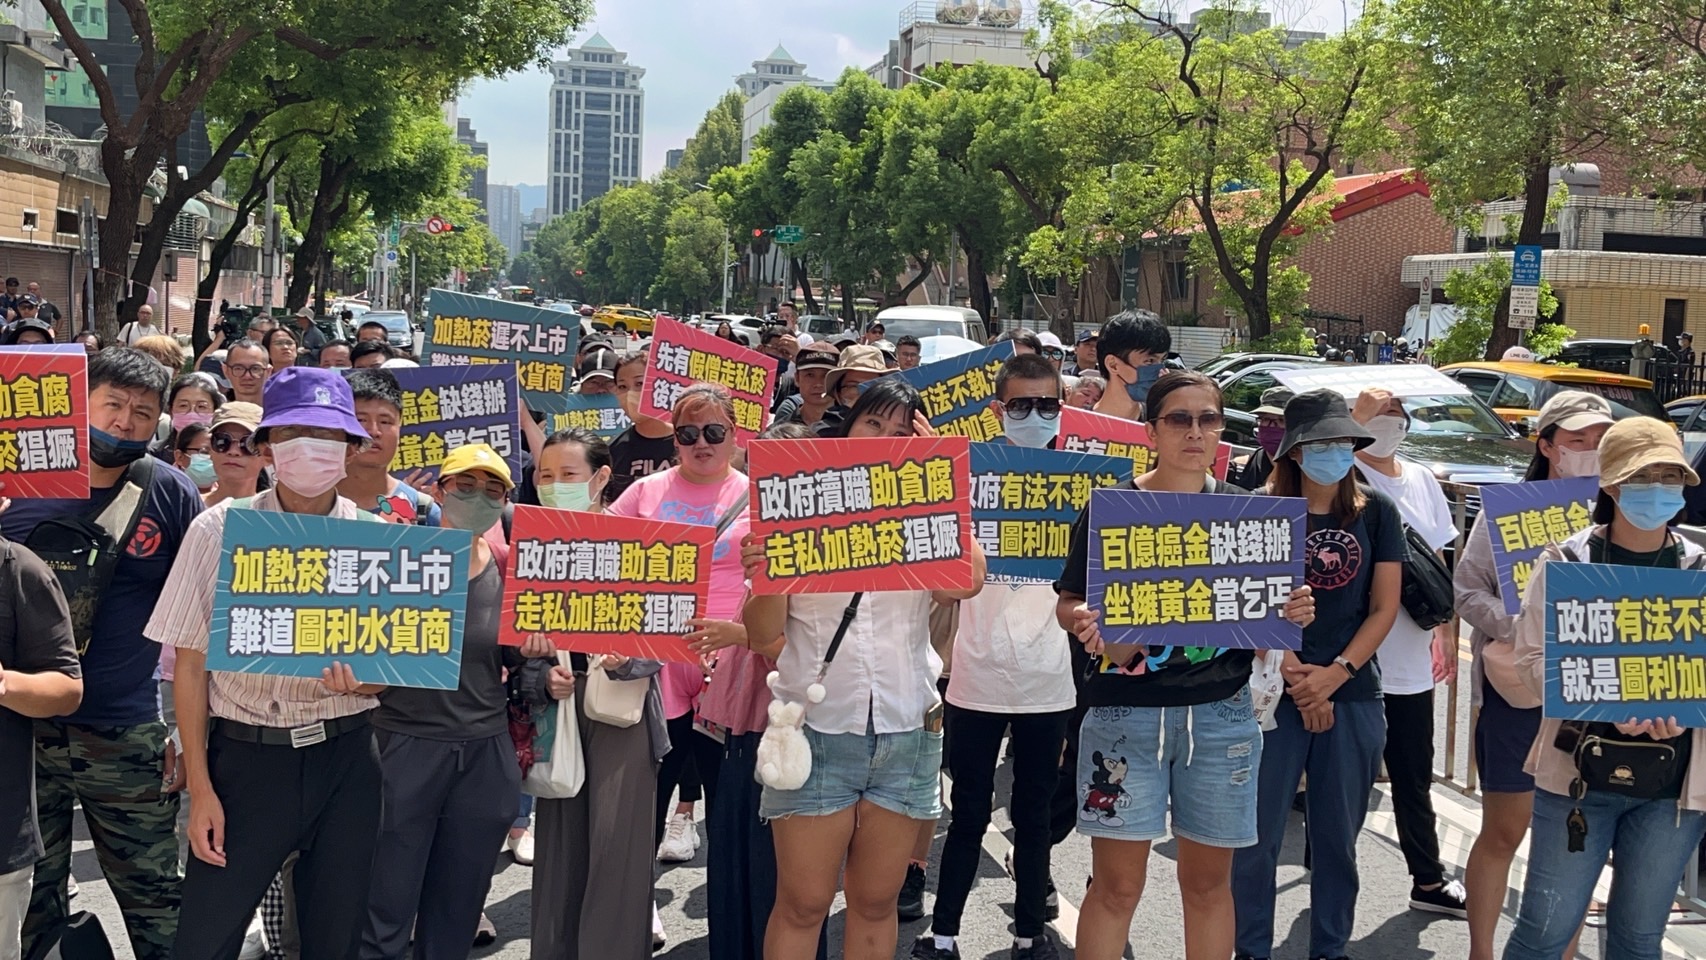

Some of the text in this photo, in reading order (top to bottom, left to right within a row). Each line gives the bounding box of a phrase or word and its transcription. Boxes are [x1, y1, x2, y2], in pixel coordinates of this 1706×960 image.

[432, 315, 567, 356] 加熱菸遲不上市
[656, 341, 767, 396] 先有假僧走私菸
[630, 459, 673, 476] FILA
[758, 458, 954, 520] 政府瀆職助貪腐
[766, 514, 961, 578] 走私加熱菸猖獗
[971, 520, 1070, 557] 是圖利加
[1100, 518, 1291, 570] 百億癌金缺錢辦
[1496, 499, 1597, 552] 百億癌金
[232, 548, 451, 595] 加熱菸遲不上市
[517, 540, 697, 582] 政府瀆職助貪腐
[515, 591, 696, 633] 走私加熱菸猖獗
[1104, 576, 1292, 625] 坐擁黃金當乞丐
[229, 608, 451, 655] 難道圖利水貨商
